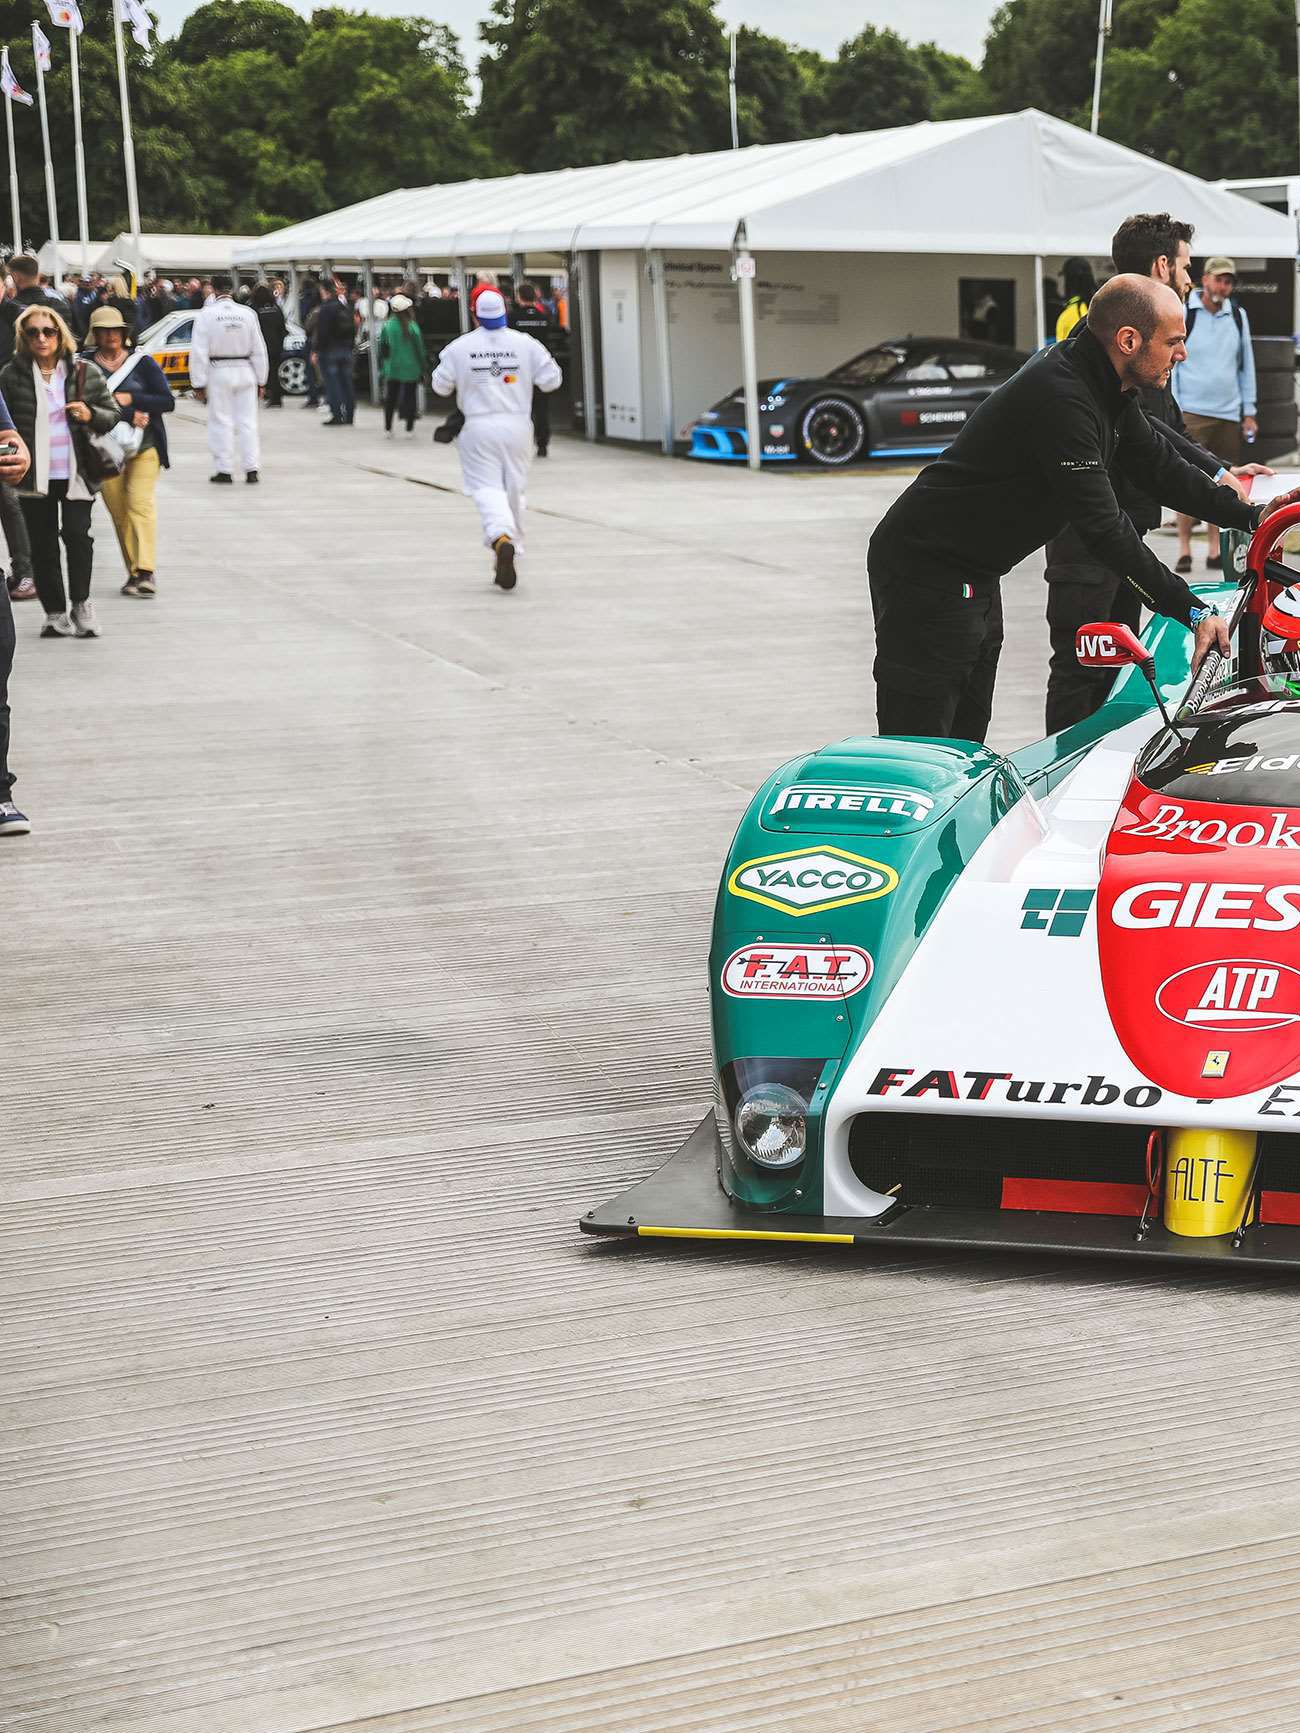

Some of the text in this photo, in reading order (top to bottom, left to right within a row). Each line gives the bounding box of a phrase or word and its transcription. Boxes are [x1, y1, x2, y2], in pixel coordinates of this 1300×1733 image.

[1075, 635, 1117, 657] JVC
[769, 785, 934, 822] PIRELLI
[757, 869, 872, 890] YACCO
[739, 980, 844, 993] INTERNATIONAL
[1200, 966, 1281, 1010] ATP
[866, 1067, 1162, 1108] FATurbo
[1170, 1157, 1234, 1204] ALTE
